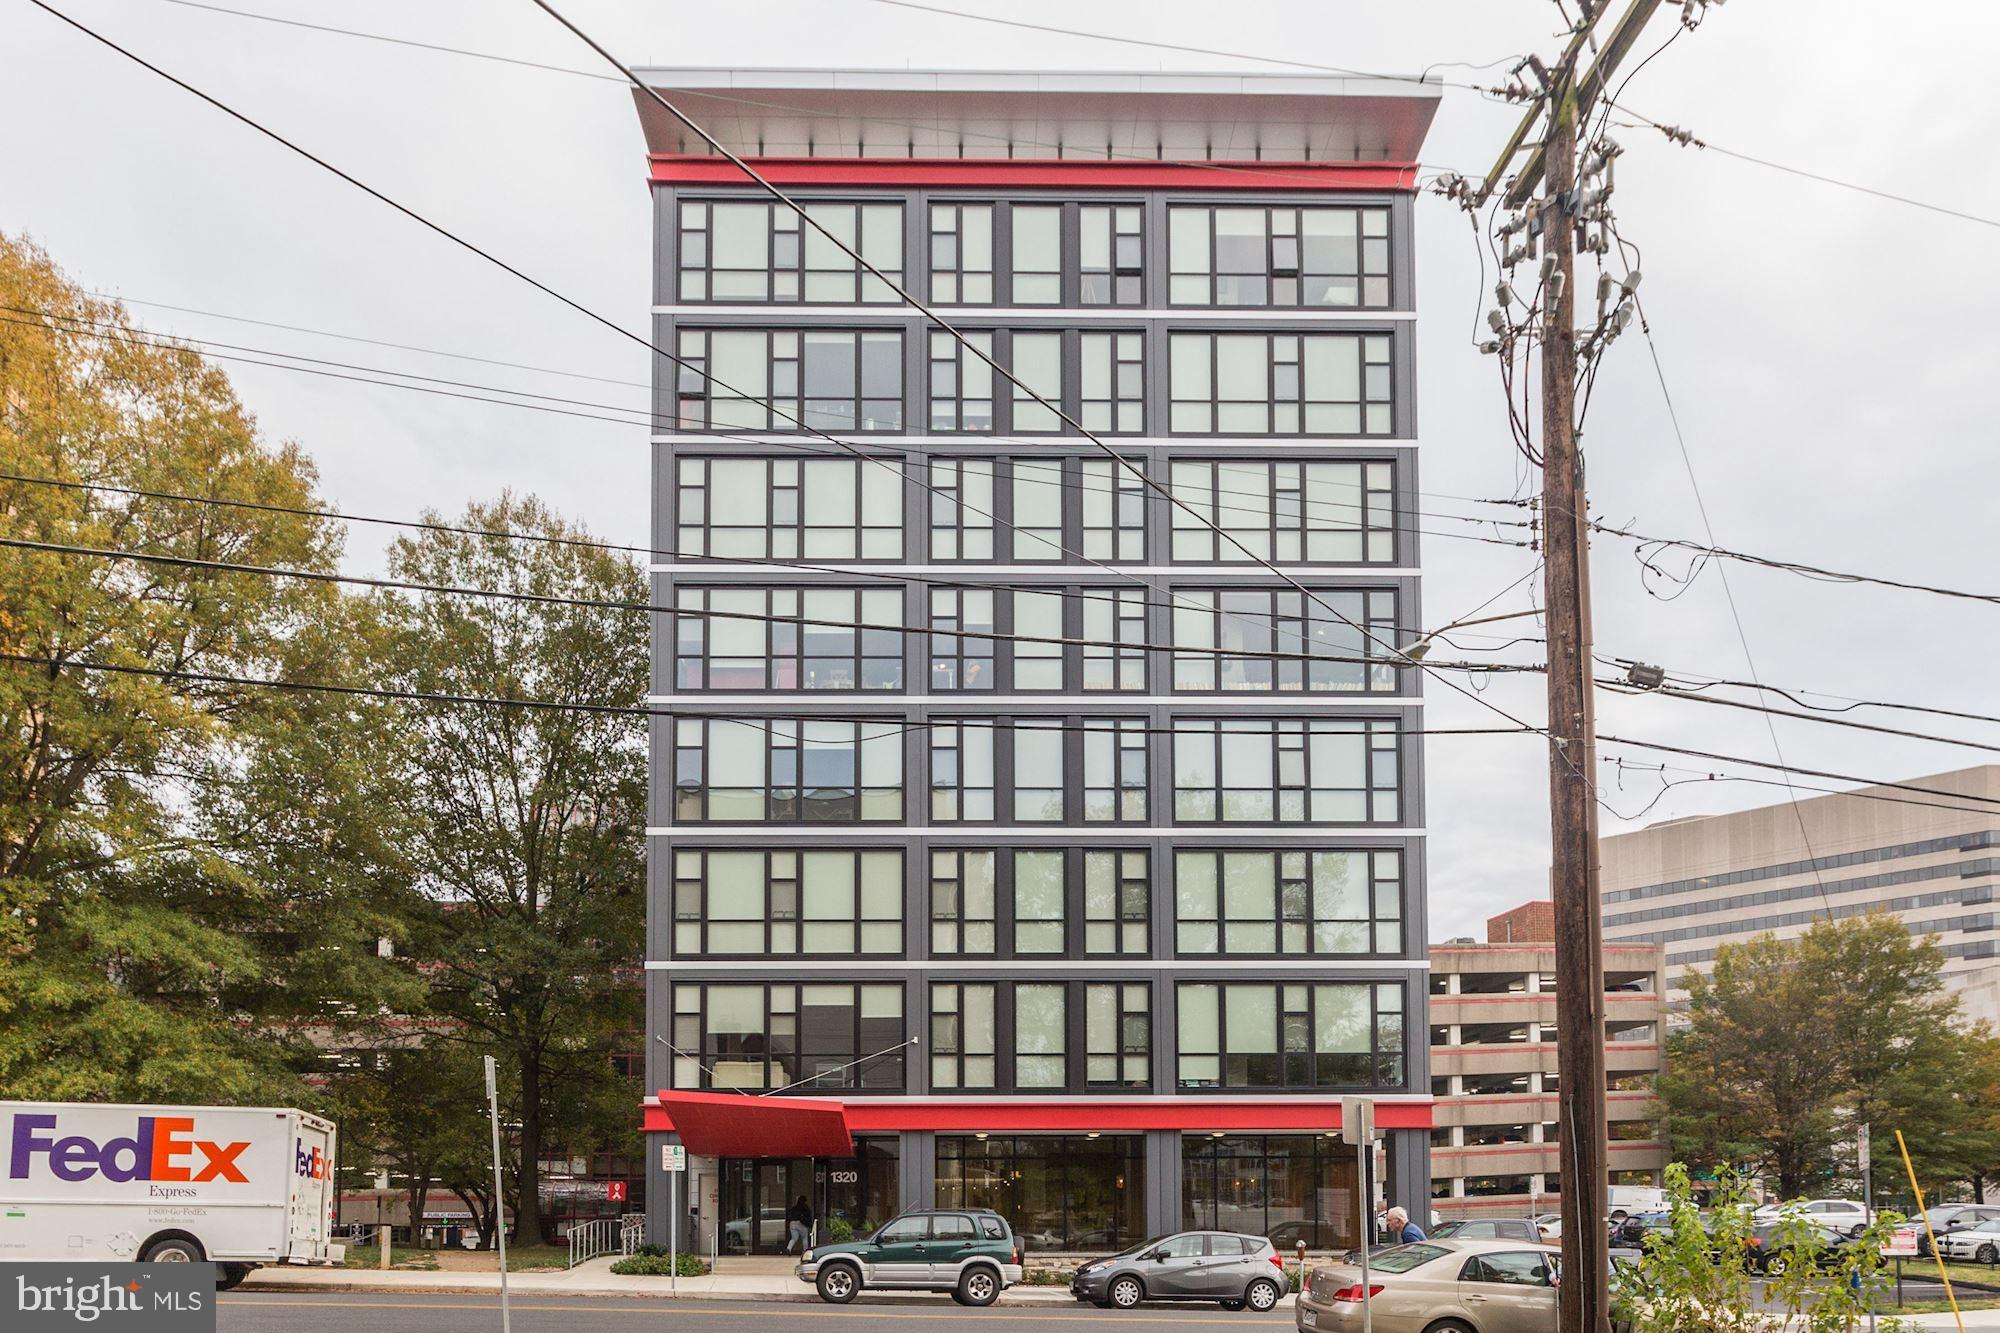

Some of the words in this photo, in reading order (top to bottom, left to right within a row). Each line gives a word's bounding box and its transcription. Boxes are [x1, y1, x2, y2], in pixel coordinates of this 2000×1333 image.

[9, 1113, 251, 1183] FedEx
[295, 1136, 332, 1181] FedEx
[831, 1171, 858, 1183] 1320
[149, 1185, 197, 1199] Express
